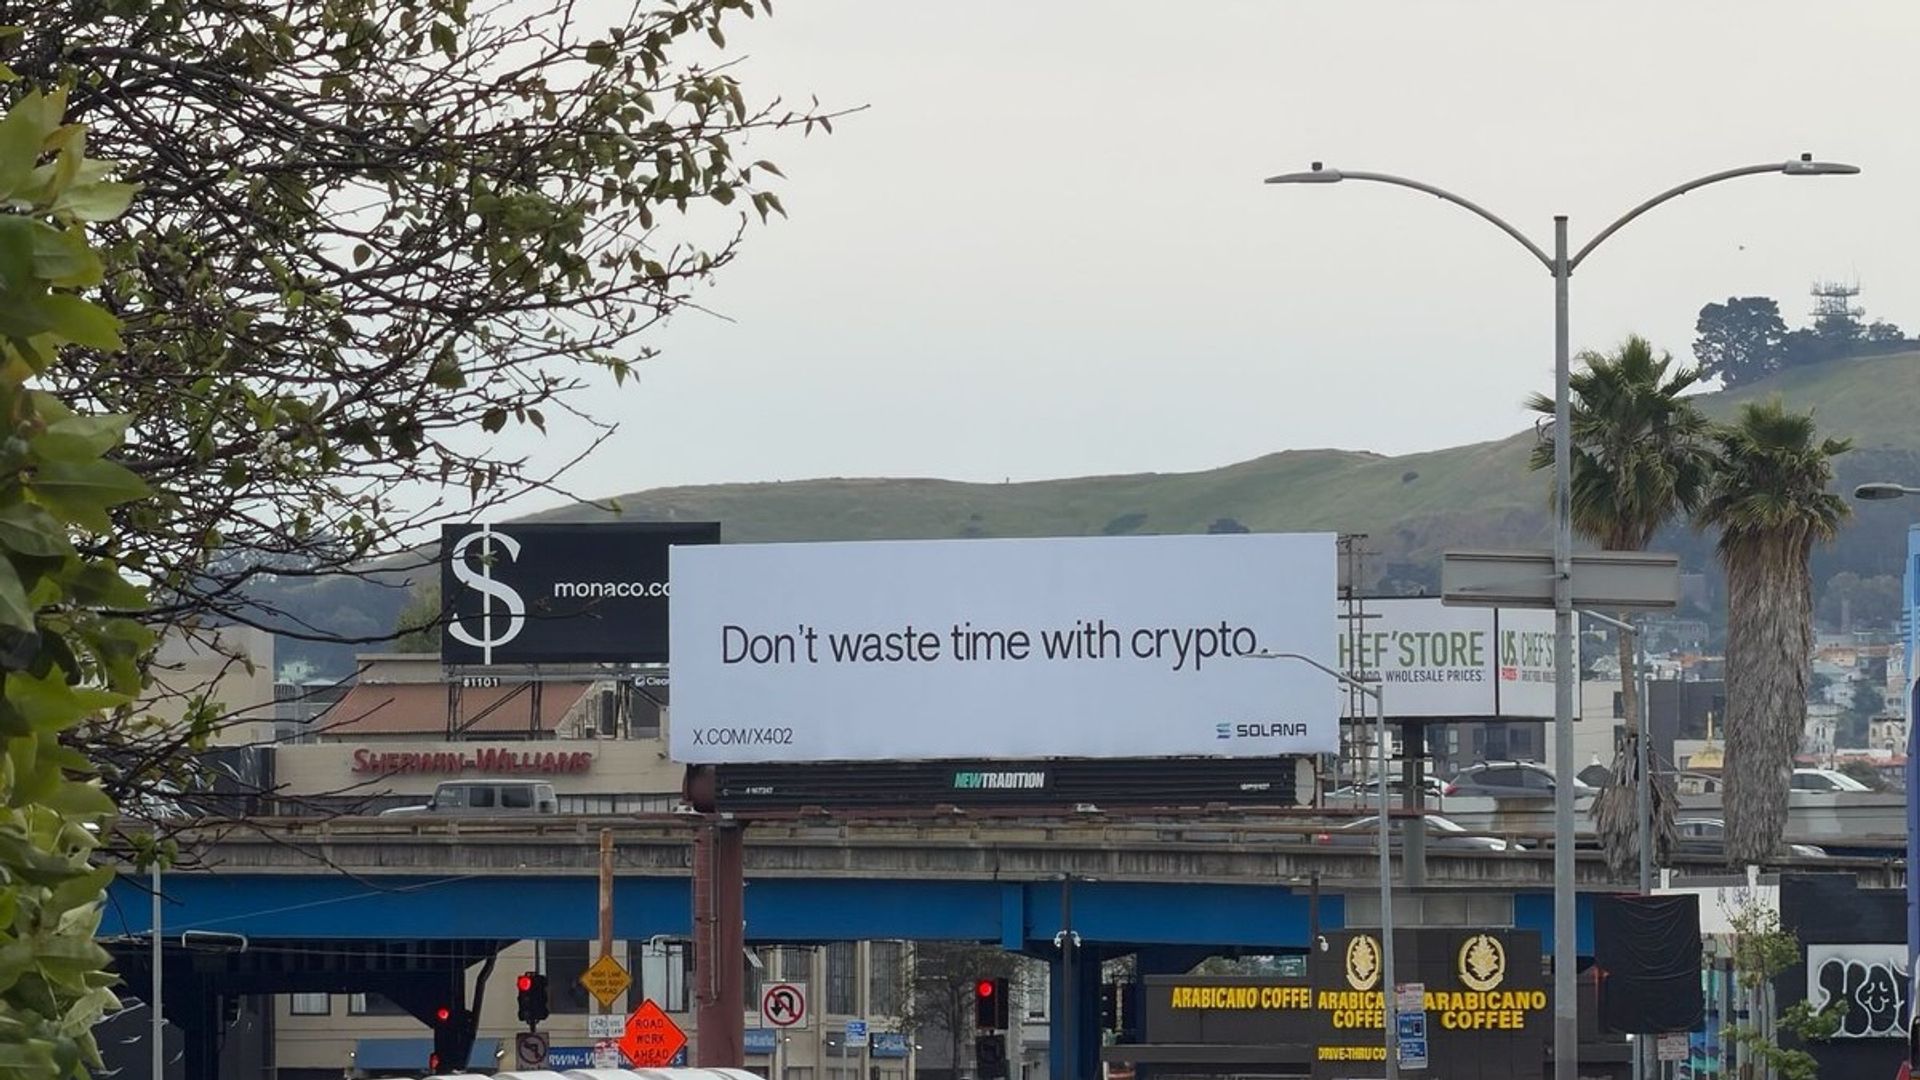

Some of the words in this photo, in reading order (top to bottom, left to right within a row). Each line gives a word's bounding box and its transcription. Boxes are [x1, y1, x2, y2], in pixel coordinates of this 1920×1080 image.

[554, 582, 670, 597] monaco.co
[722, 624, 818, 664] Don't
[828, 629, 941, 662] waste
[949, 622, 1030, 661] time
[1041, 620, 1122, 659] with
[1131, 619, 1269, 671] crypto.
[1338, 631, 1484, 668] HEF'STORE
[1386, 670, 1443, 682] WHOLESALE
[693, 728, 793, 745] X.COM/X402
[1236, 724, 1307, 737] SOLANA
[352, 748, 593, 775] SHERWIN-WILLIAMS
[1172, 987, 1259, 1009] ARABICANO
[1318, 991, 1386, 1010] ARABICA
[1423, 991, 1547, 1011] ARABICANO
[635, 1018, 664, 1028] ROAD
[1332, 1009, 1388, 1029] COFFE
[1441, 1010, 1525, 1030] COFFEE
[636, 1034, 665, 1044] WORK
[633, 1049, 669, 1060] AHEAD
